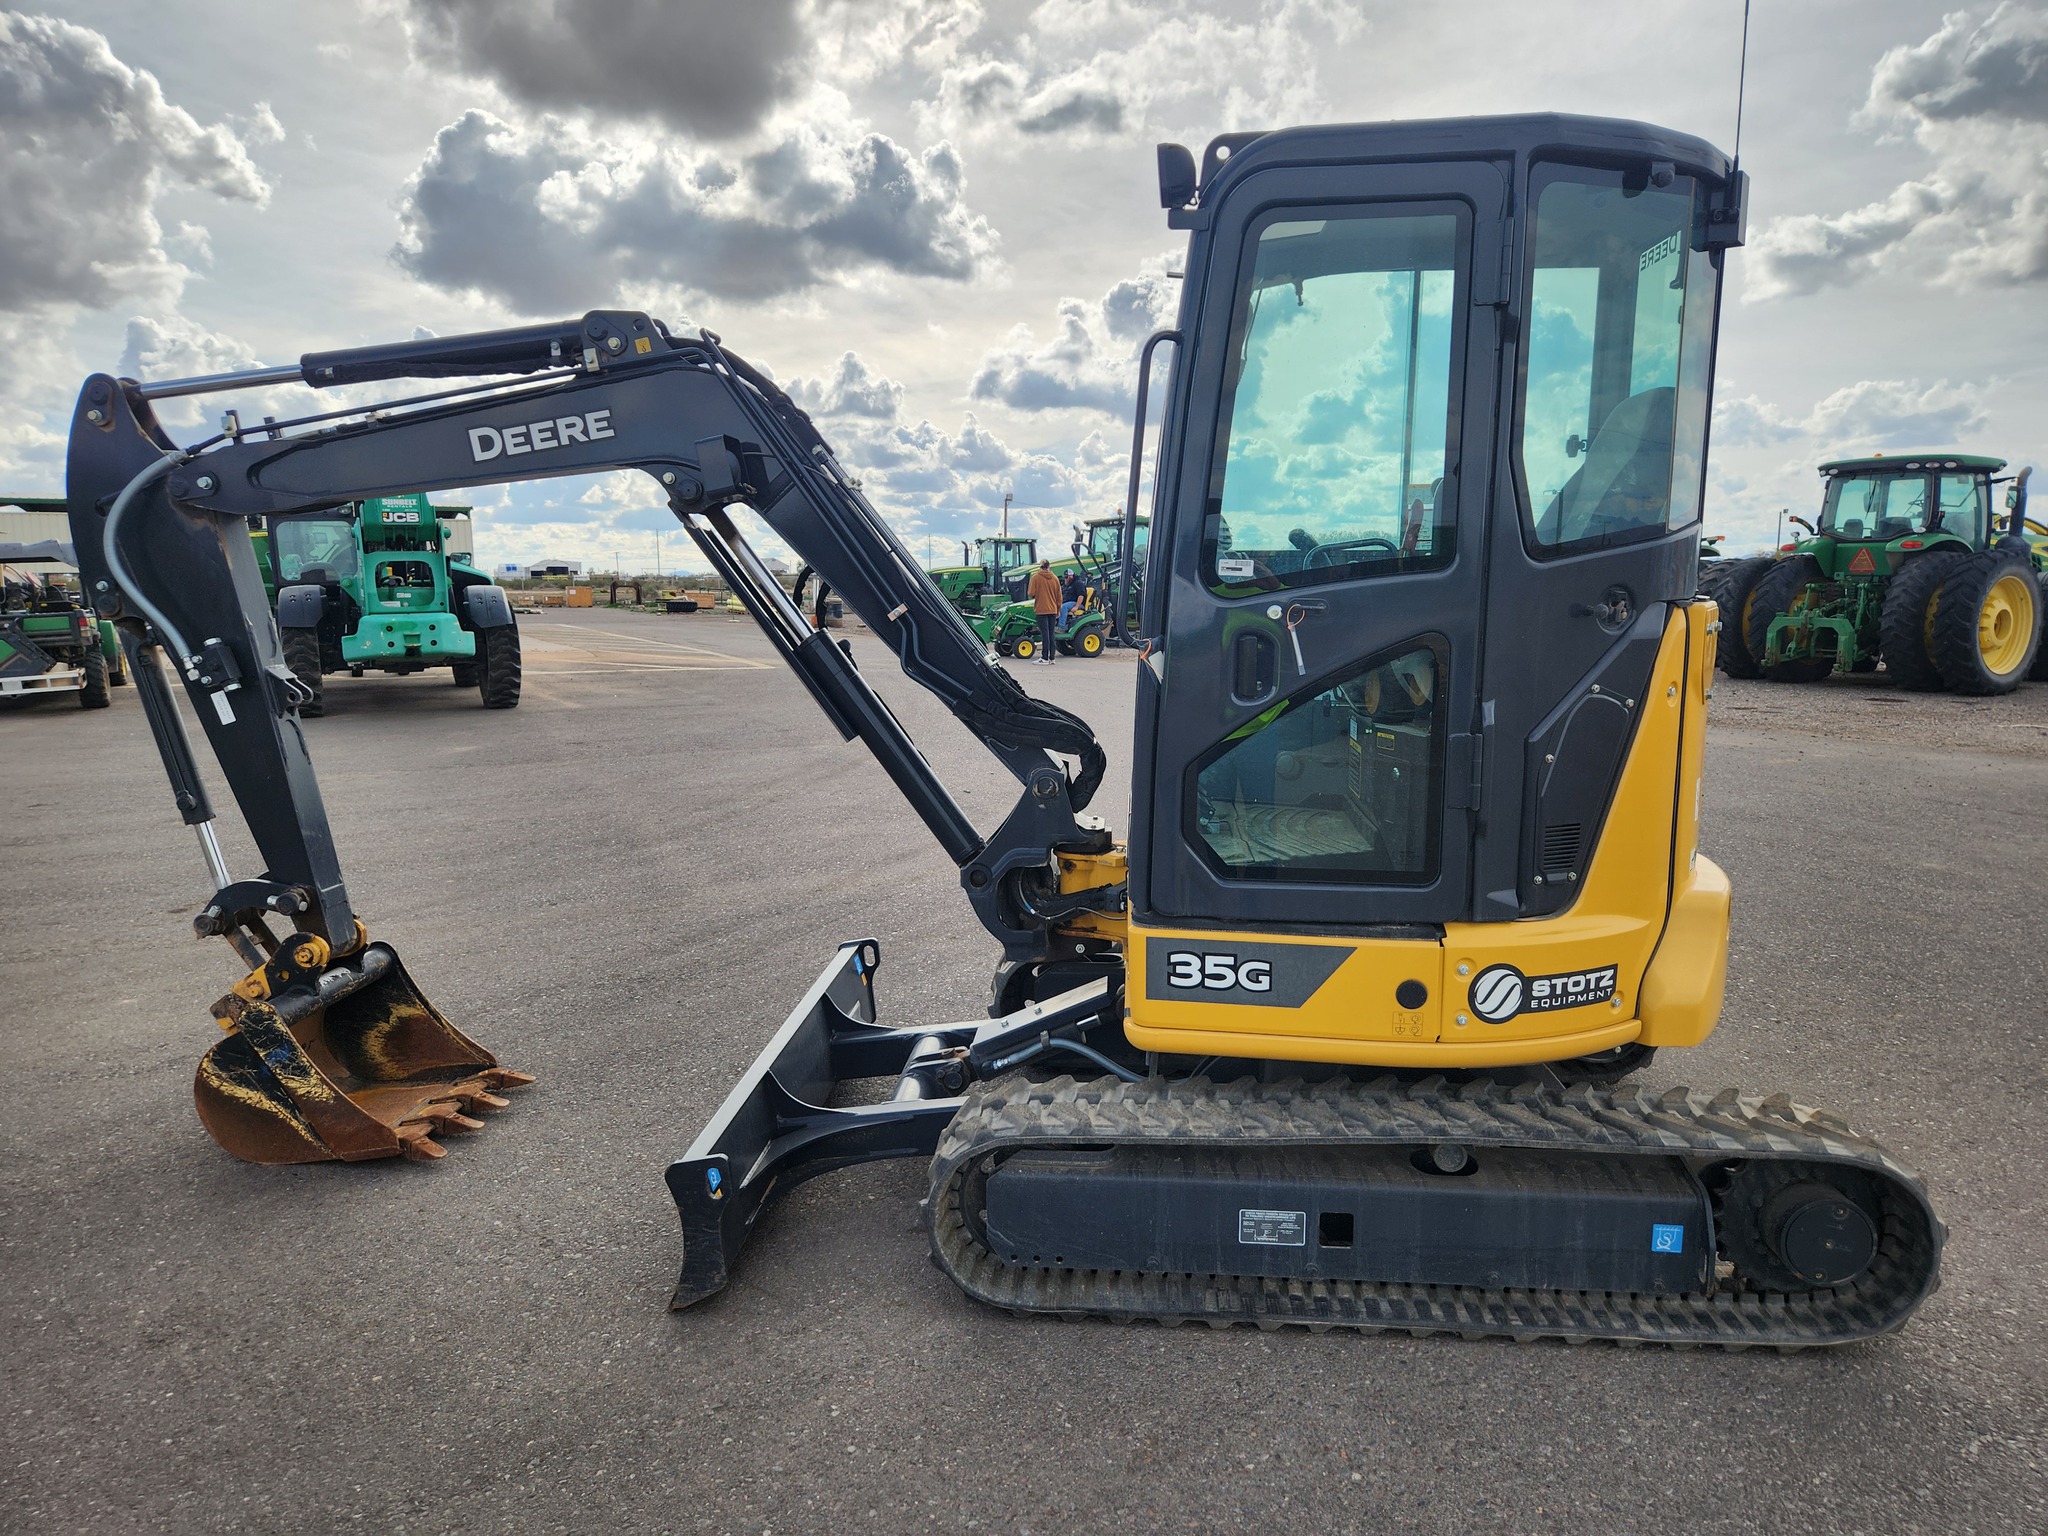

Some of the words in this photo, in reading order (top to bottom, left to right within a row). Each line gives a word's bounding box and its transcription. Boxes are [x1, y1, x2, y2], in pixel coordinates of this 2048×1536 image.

[467, 409, 615, 462] DEERE
[382, 512, 420, 523] JCB
[1168, 951, 1272, 992] 35G
[1531, 968, 1615, 997] STOTZ
[1530, 987, 1613, 1009] EQUIPMENT
